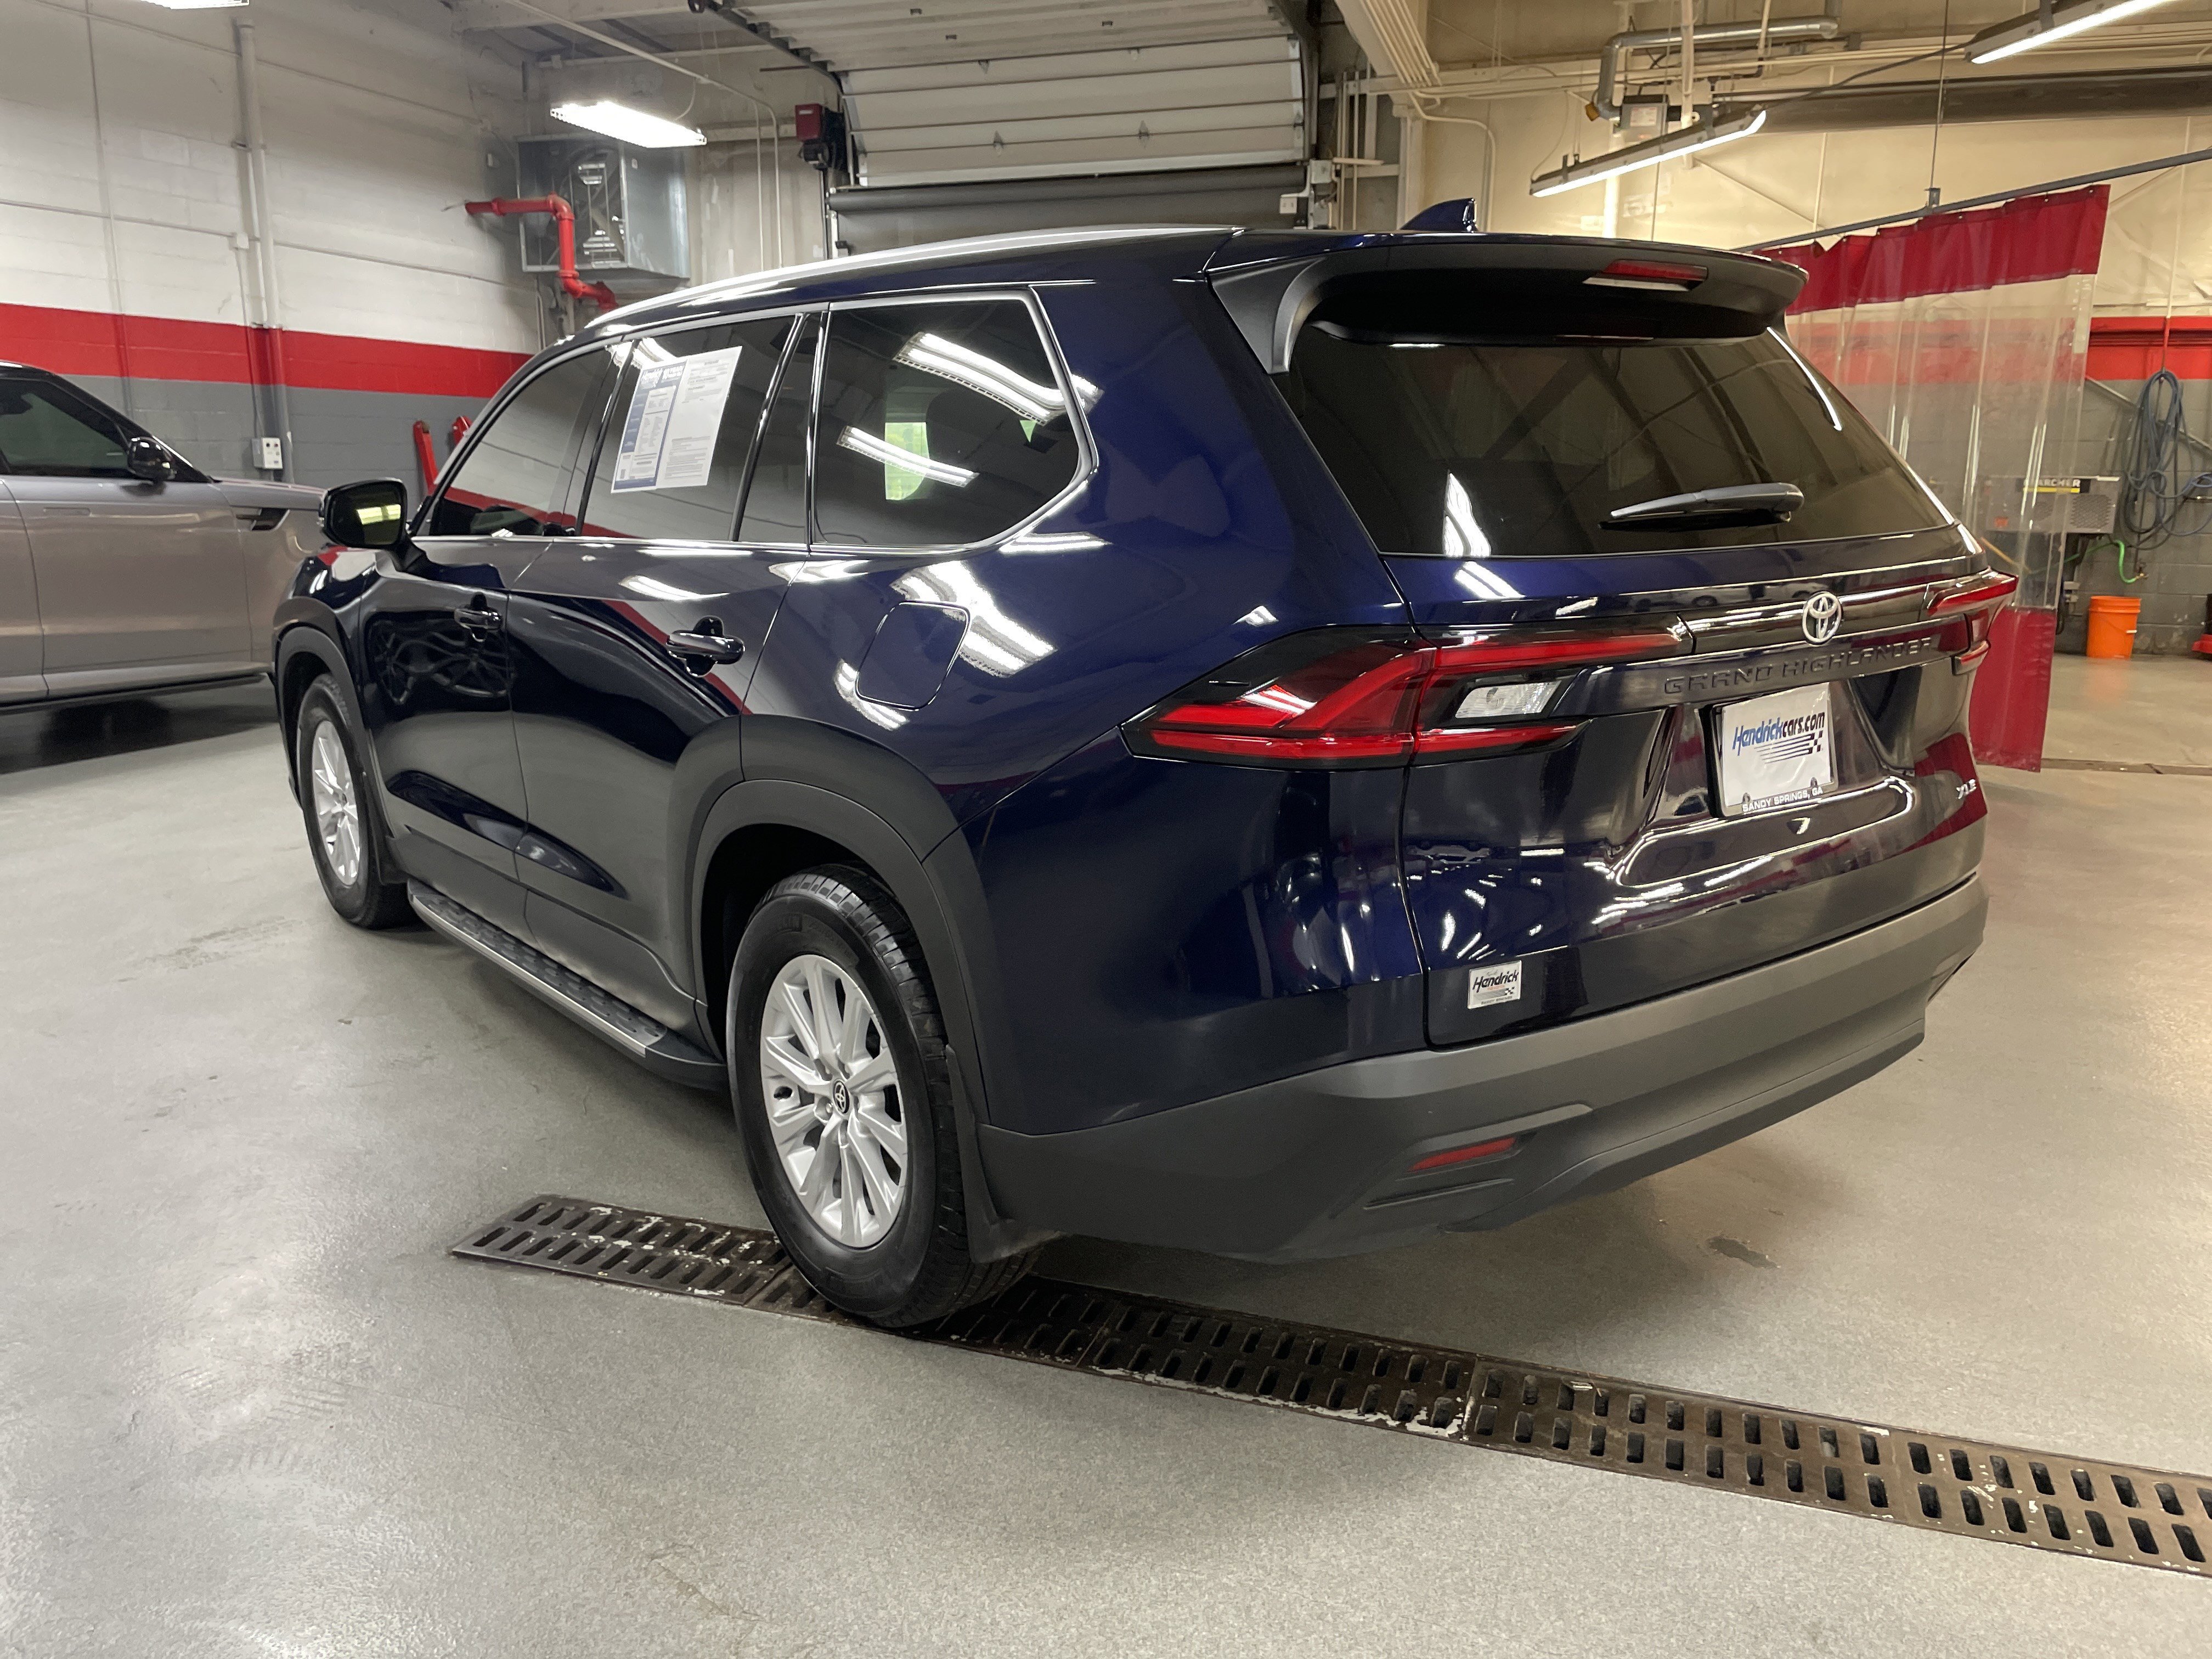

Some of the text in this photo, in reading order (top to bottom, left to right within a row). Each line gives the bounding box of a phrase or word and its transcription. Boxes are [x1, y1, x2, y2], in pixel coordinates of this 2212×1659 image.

[1664, 637, 1932, 694] GRAND HIGHLANDER
[1732, 712, 1825, 757] Hendrickcars.com
[1741, 786, 1823, 812] SANDY SPRINGS, GA
[1956, 778, 1977, 799] XLE
[1472, 969, 1519, 993] Hendrick
